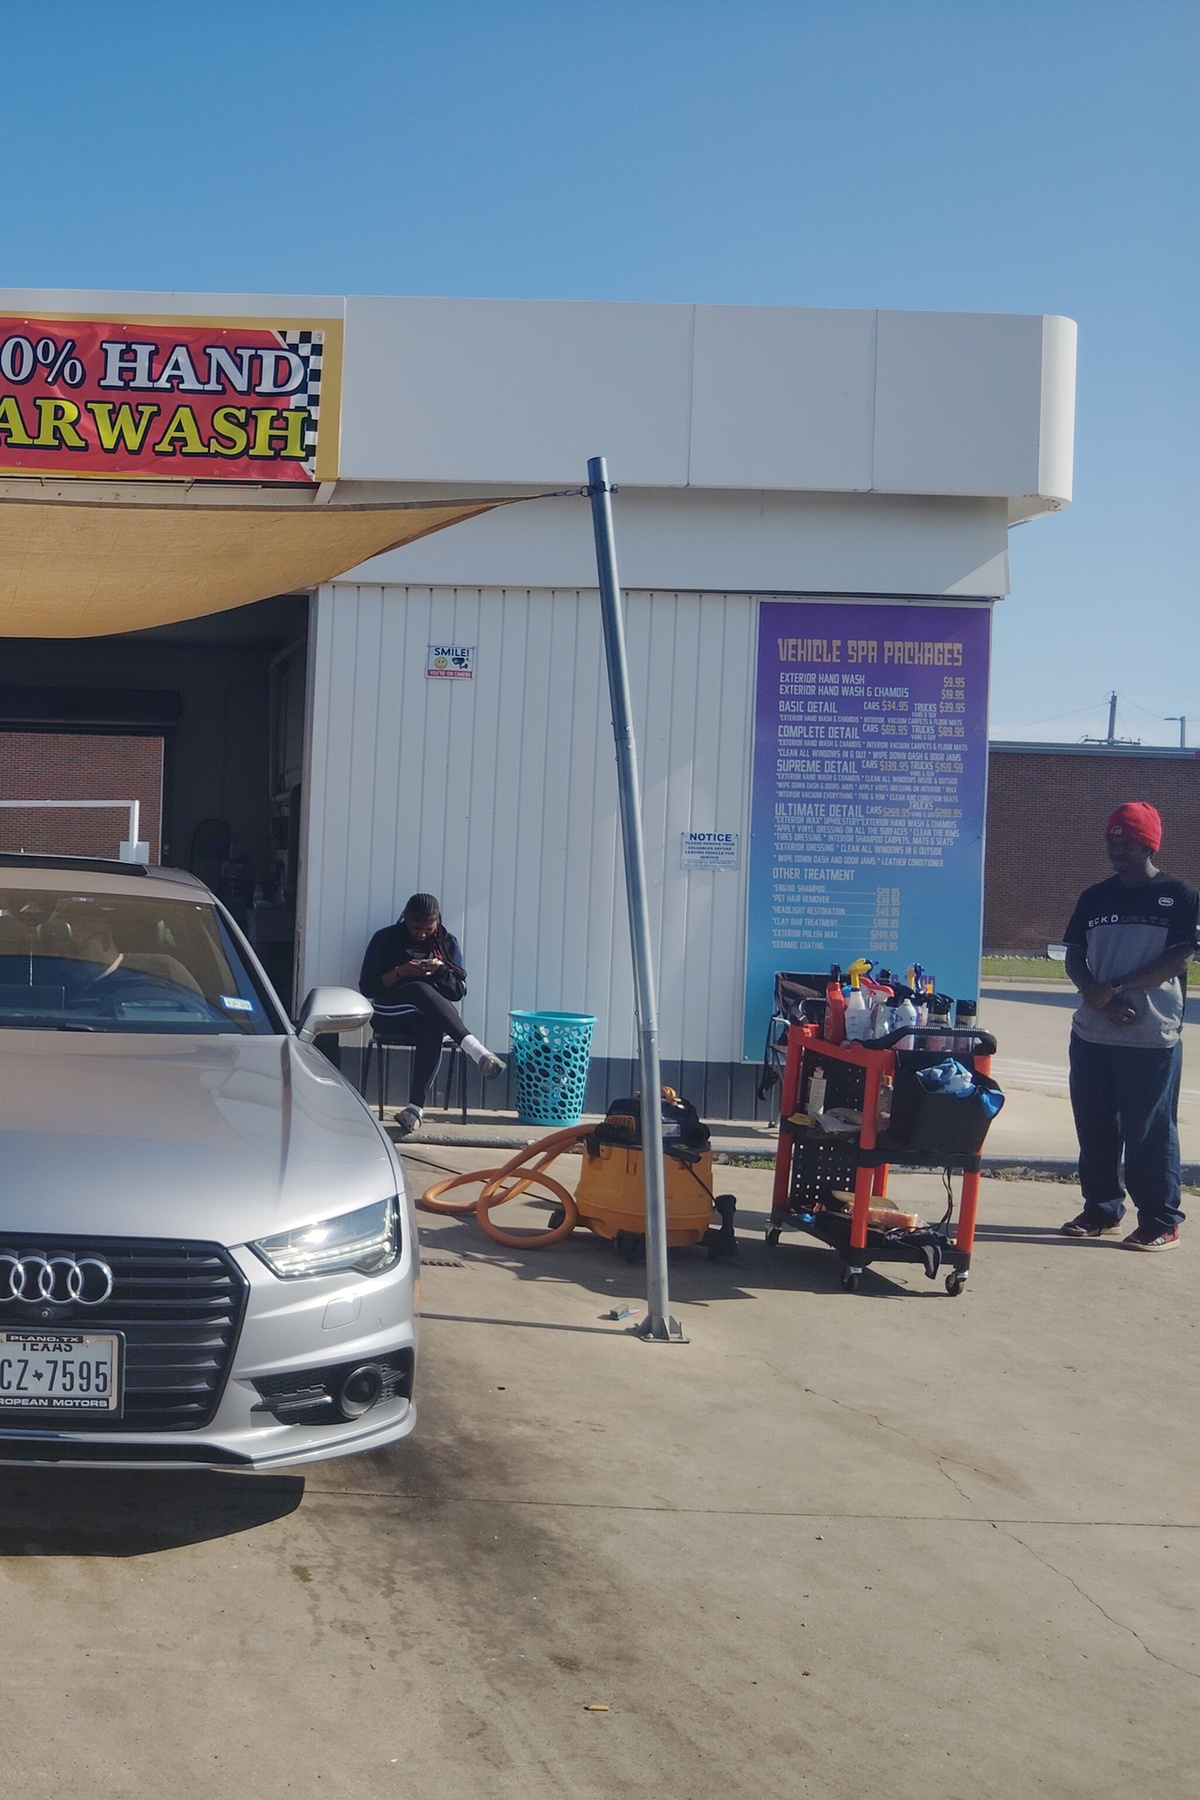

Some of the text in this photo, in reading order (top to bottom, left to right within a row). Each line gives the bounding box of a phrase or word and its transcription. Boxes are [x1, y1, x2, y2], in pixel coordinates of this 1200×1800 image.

[100, 341, 306, 395] HAND
[434, 647, 469, 657] SMILE!
[778, 639, 963, 666] VEHICLE SPA PACKAGES
[780, 673, 965, 688] EXTERIOR HAND WASH $9.95
[780, 685, 816, 695] EXTERIOR
[818, 686, 839, 696] HAND
[841, 686, 865, 696] WASH
[874, 687, 909, 698] CHAMOIS
[779, 700, 965, 713] BASIC DETAIL CARS $34.95 TRUCKS $39.95
[778, 724, 965, 739] COMPLETE DETAIL CARS $69.95 TRUCKS $89.95
[777, 759, 821, 772] SUPREME
[824, 761, 858, 773] DETAIL
[862, 760, 878, 768] CARS
[910, 761, 934, 770] TRUCKS
[775, 803, 825, 816] ULTIMATE
[829, 804, 864, 817] DETAIL
[866, 806, 882, 814] CARS
[909, 801, 933, 810] TRUCKS
[690, 833, 732, 842] NOTICE
[773, 868, 855, 881] OTHER TREATMENT
[53, 1398, 108, 1407] MOTORS
